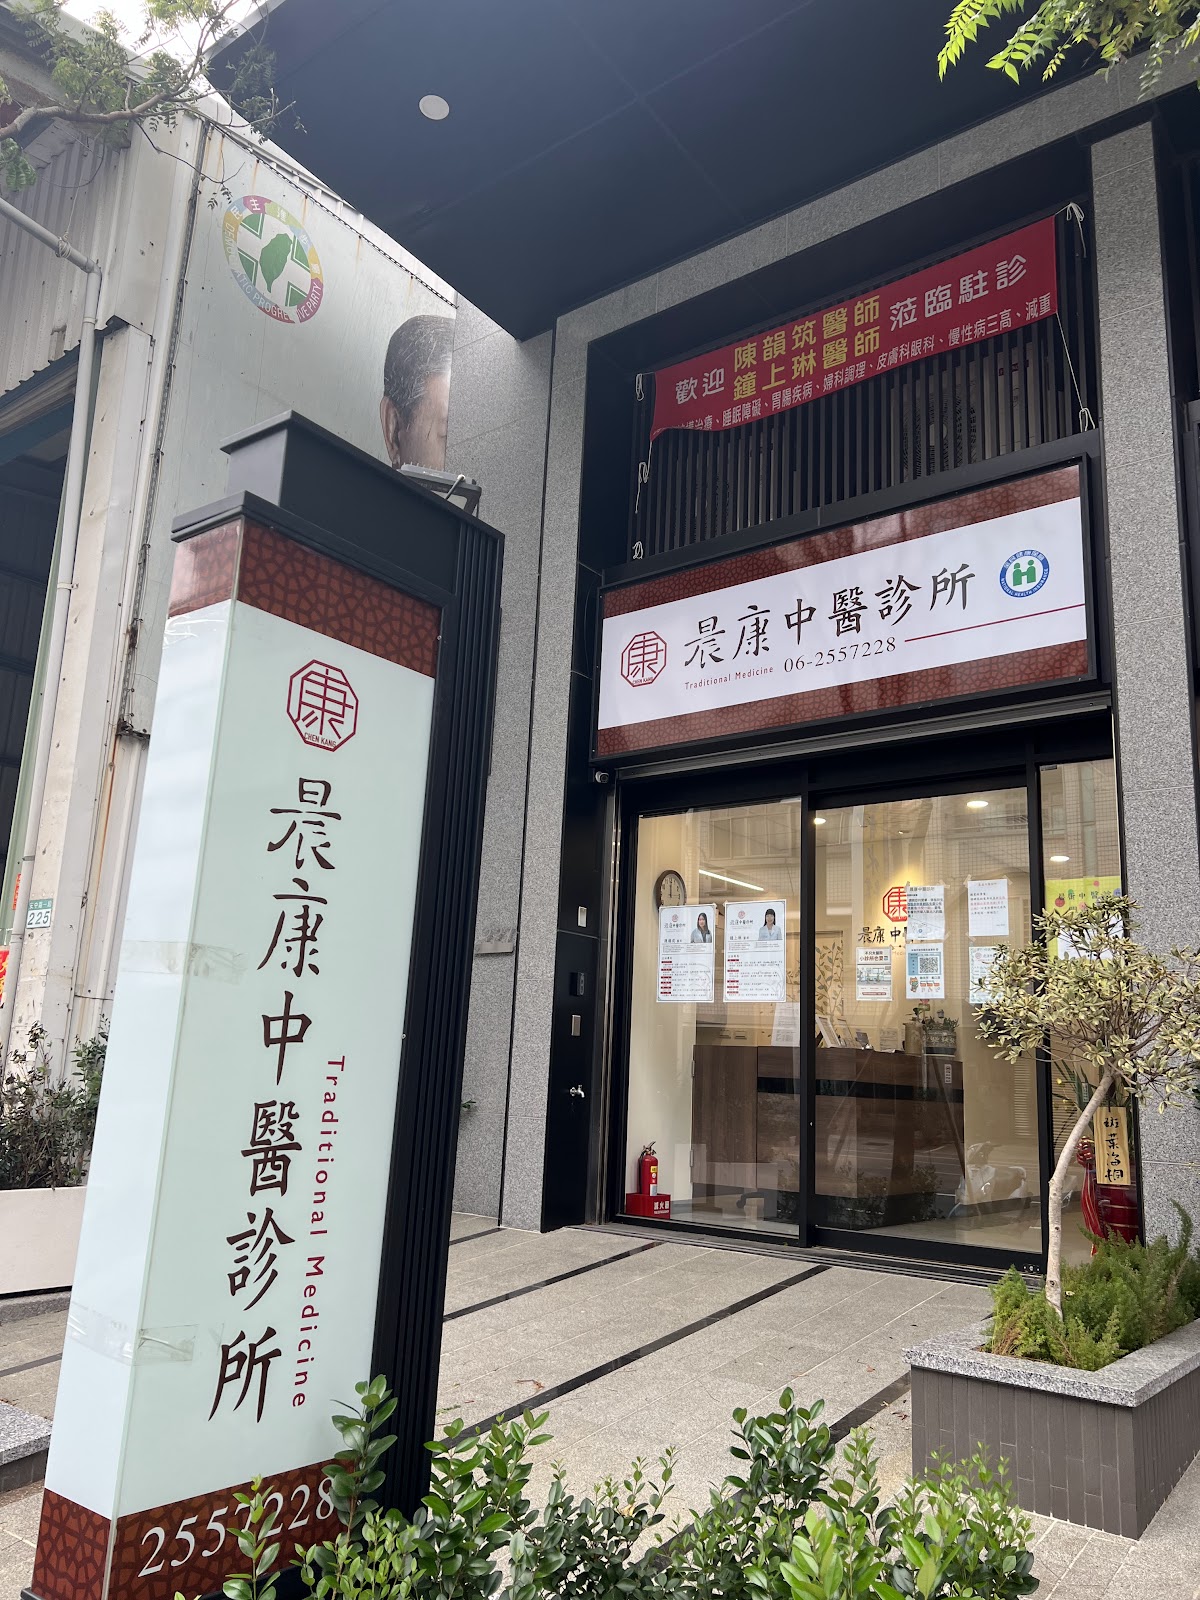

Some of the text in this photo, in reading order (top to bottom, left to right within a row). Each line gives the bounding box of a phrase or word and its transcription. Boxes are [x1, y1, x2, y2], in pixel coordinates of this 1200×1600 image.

[889, 254, 1027, 332] 蒞臨駐診
[733, 294, 881, 373] 陳韻筑醫師
[733, 326, 881, 402] 鐘上琳醫師
[675, 367, 725, 405] 歡迎
[684, 563, 976, 669] 晨康中醫診所
[685, 665, 774, 690] Traditional Medicine
[784, 636, 897, 673] 06-2557228
[304, 732, 337, 748] CHEN KANG
[27, 911, 50, 926] 225
[858, 926, 907, 944] 晨康中
[208, 777, 342, 1424] 晨康中醫診所
[291, 1055, 346, 1408] Traditional Medicine
[137, 1477, 335, 1578] 2557228
